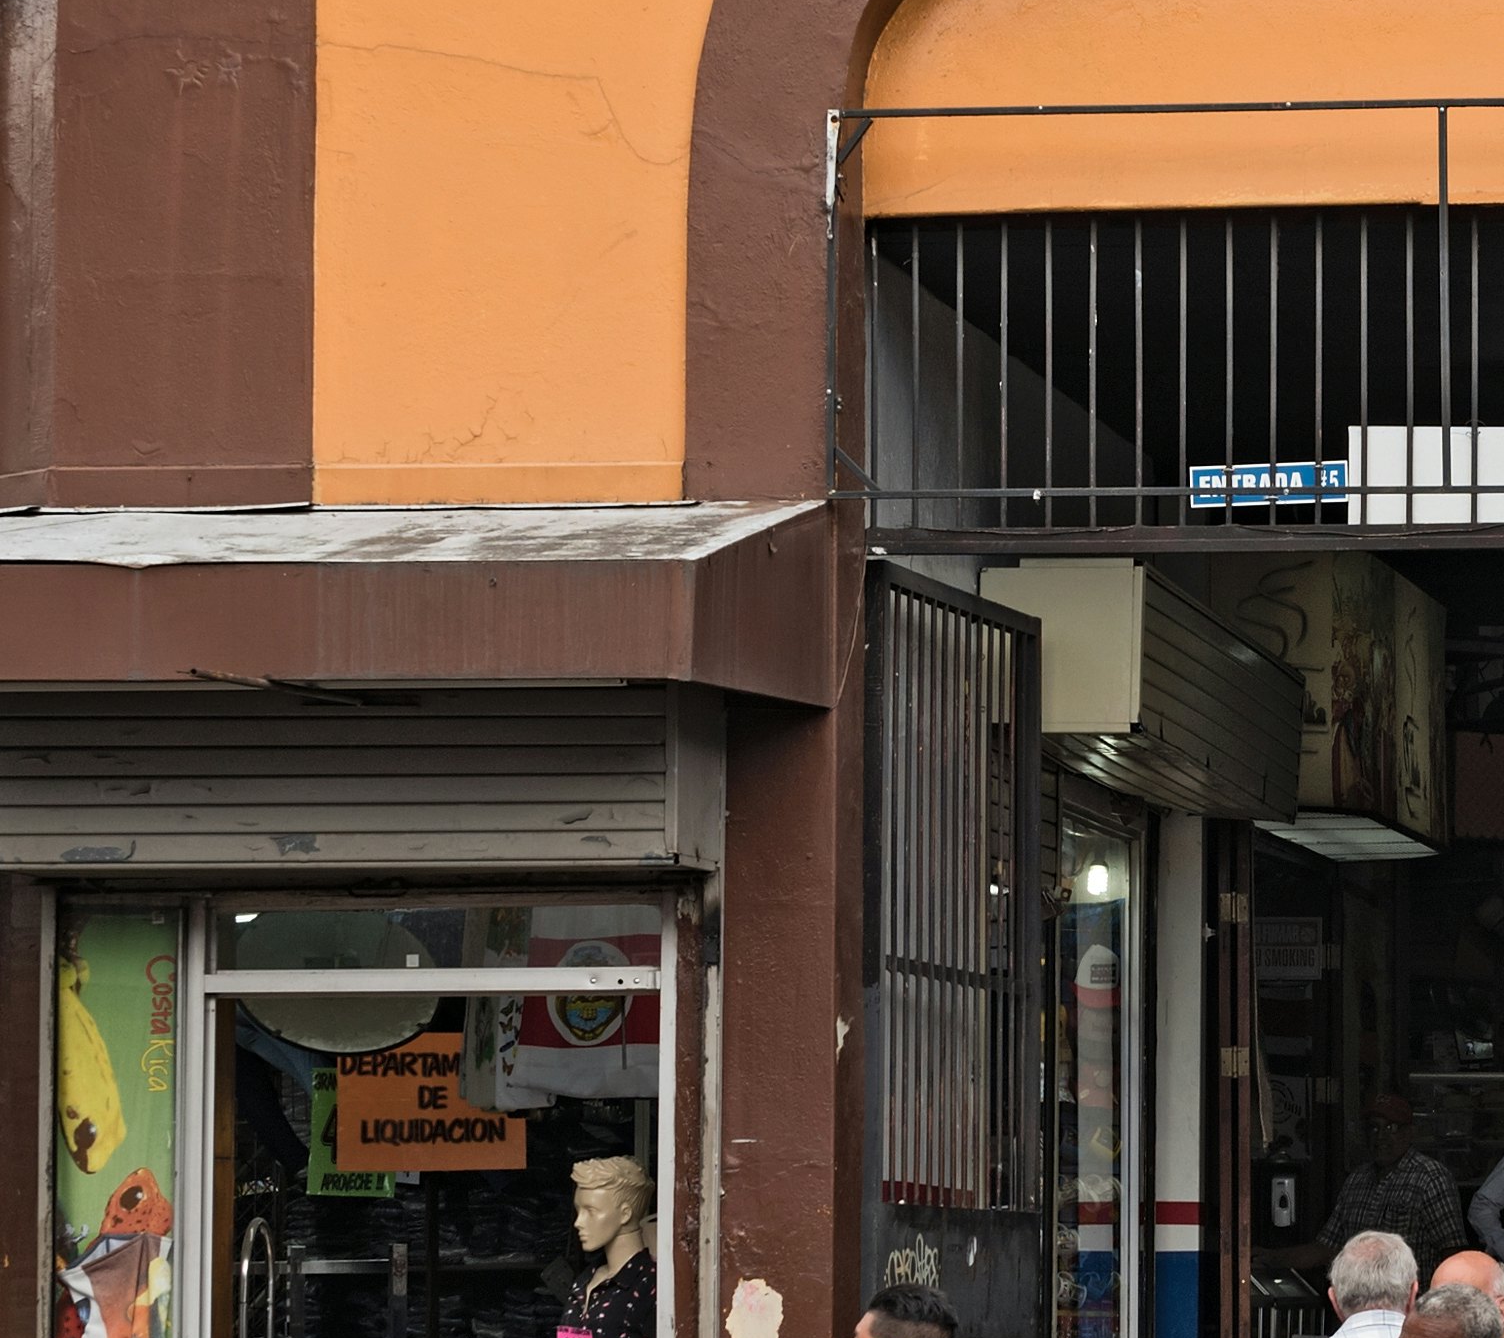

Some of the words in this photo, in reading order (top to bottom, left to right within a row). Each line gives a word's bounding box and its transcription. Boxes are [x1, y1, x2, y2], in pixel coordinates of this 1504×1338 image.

[1264, 948, 1316, 967] SMOKING
[145, 955, 176, 1035] Costa
[417, 1085, 448, 1111] DE
[360, 1117, 507, 1147] LIQUIDACION
